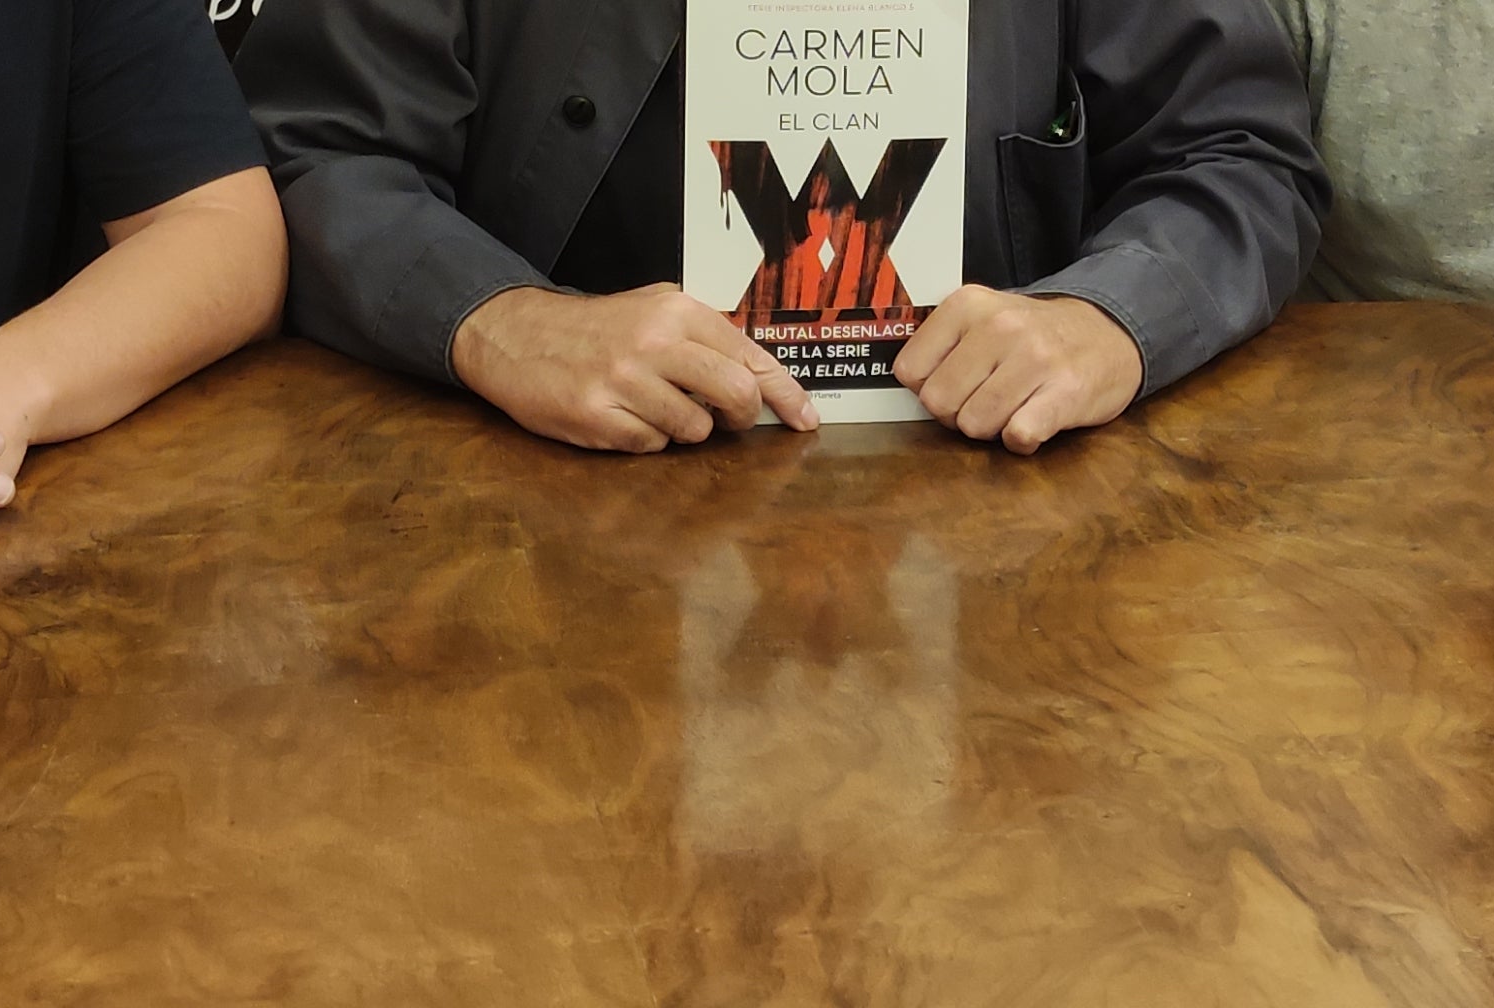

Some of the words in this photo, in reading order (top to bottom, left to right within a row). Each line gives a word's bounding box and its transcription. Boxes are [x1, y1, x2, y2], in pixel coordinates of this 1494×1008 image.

[836, 4, 865, 12] ELENA
[735, 28, 923, 60] CARMEN
[767, 65, 893, 96] MOLA
[779, 113, 805, 131] EL
[812, 112, 880, 131] CLAN
[754, 326, 818, 340] BRUTAL
[821, 323, 915, 339] DESENLACE
[777, 346, 799, 359] DE
[802, 345, 823, 359] LA
[826, 344, 871, 358] SERIE
[815, 363, 867, 378] ELENA
